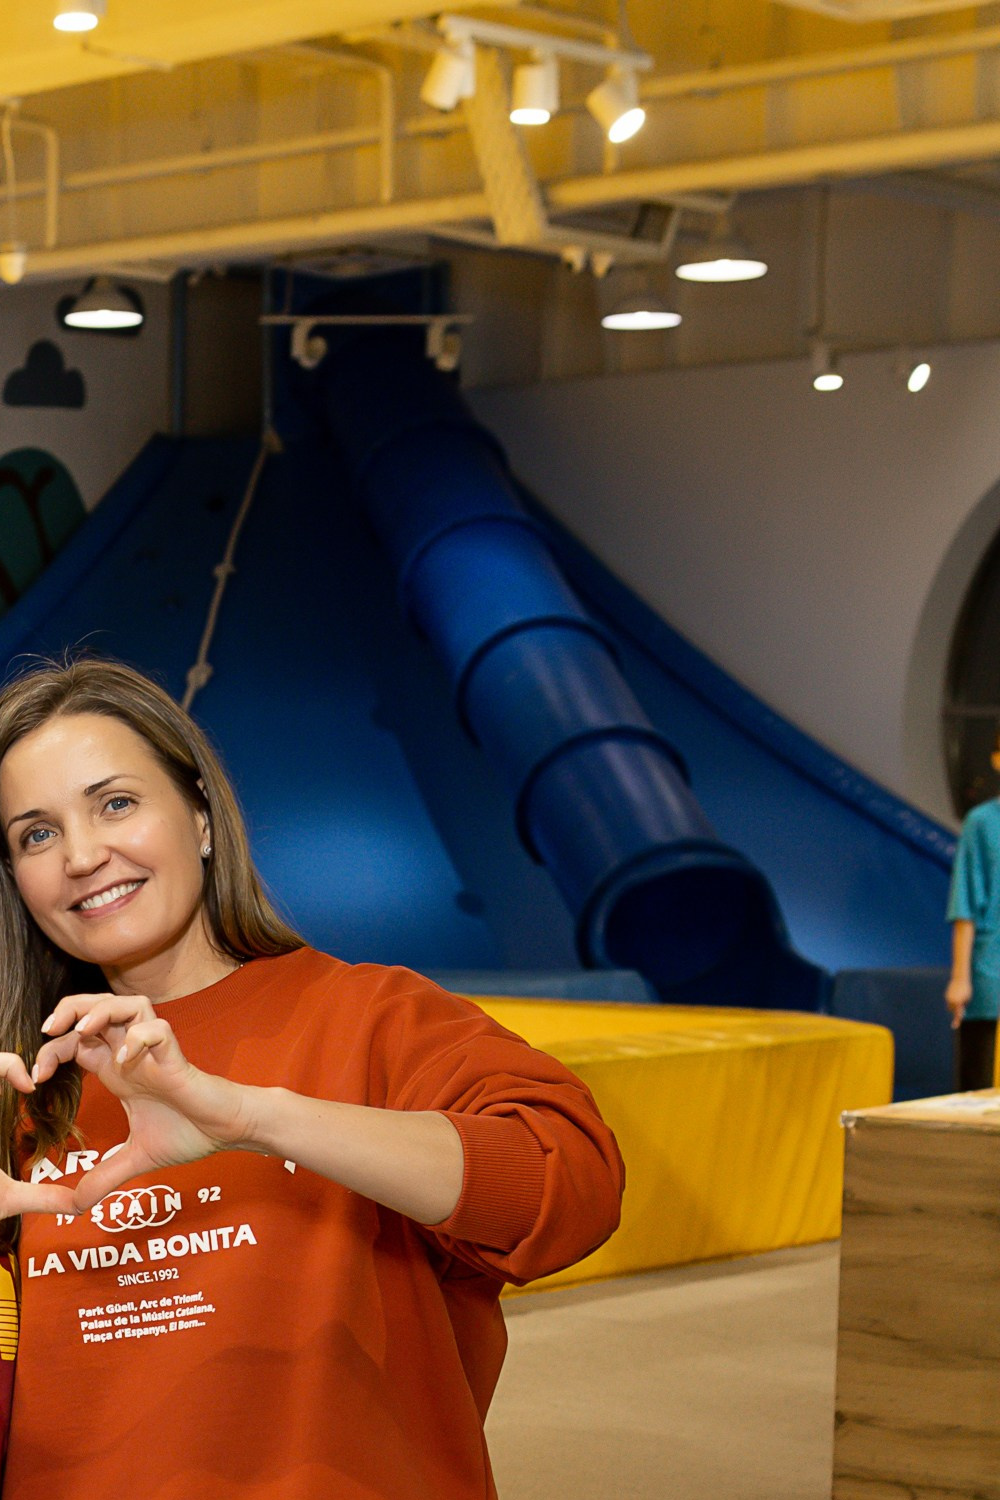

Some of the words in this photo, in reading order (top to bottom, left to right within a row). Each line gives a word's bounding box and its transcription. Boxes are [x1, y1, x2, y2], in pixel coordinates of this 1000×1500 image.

[90, 1191, 182, 1223] SPAIN
[197, 1186, 222, 1204] 92
[27, 1252, 66, 1278] LA
[68, 1242, 144, 1271] VIDA
[147, 1223, 258, 1261] BONITA
[117, 1267, 180, 1287] SINCE.1992
[78, 1306, 105, 1318] Park
[105, 1301, 138, 1314] Güell,
[139, 1299, 159, 1310] Arc
[159, 1296, 173, 1307] de
[80, 1319, 112, 1331] Palau
[113, 1316, 128, 1327] de
[129, 1314, 141, 1324] la
[141, 1309, 175, 1323] Música
[175, 1303, 216, 1317] Catalana,
[82, 1332, 113, 1344] Plaça
[114, 1324, 168, 1339] d'Espanya,
